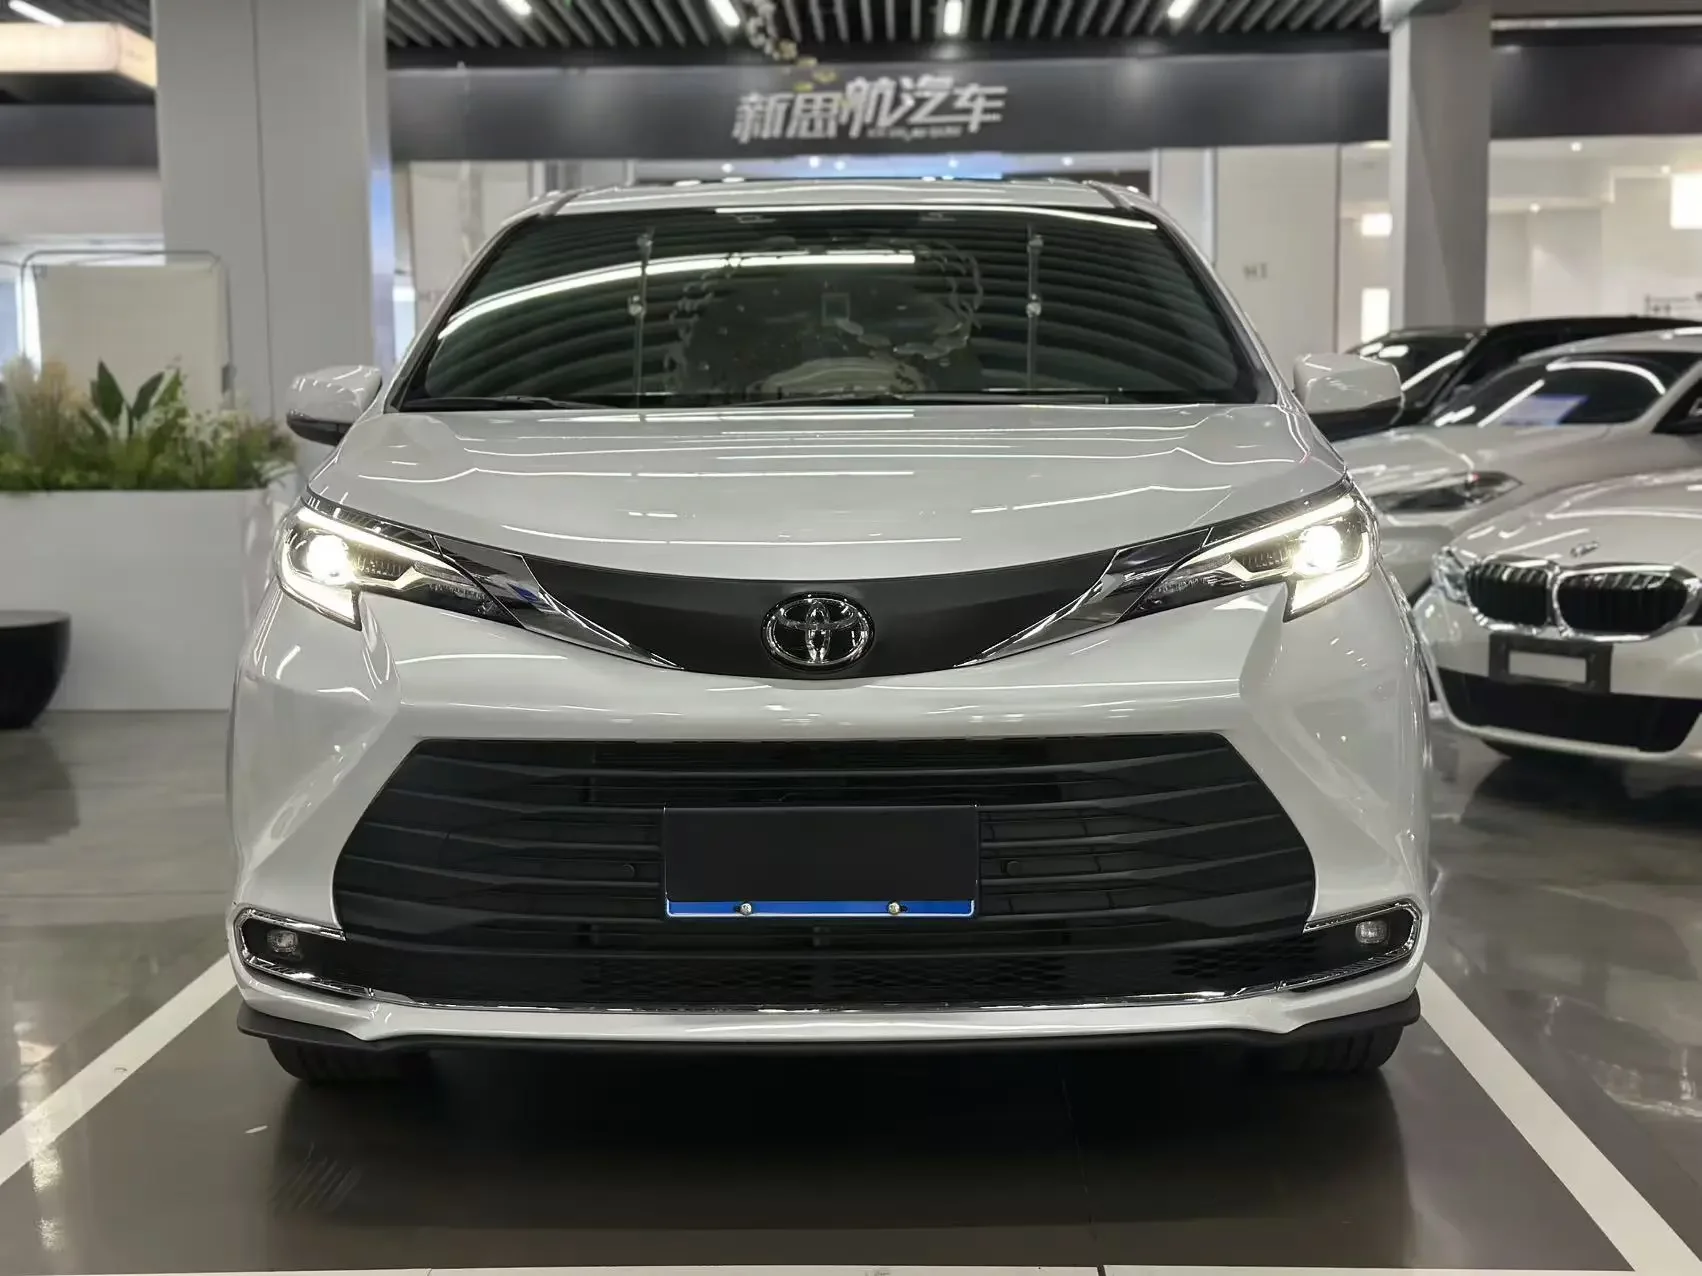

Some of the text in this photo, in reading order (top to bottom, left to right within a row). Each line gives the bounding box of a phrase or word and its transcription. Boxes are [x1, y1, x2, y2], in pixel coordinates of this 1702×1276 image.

[732, 75, 1008, 143] 新思航汽车
